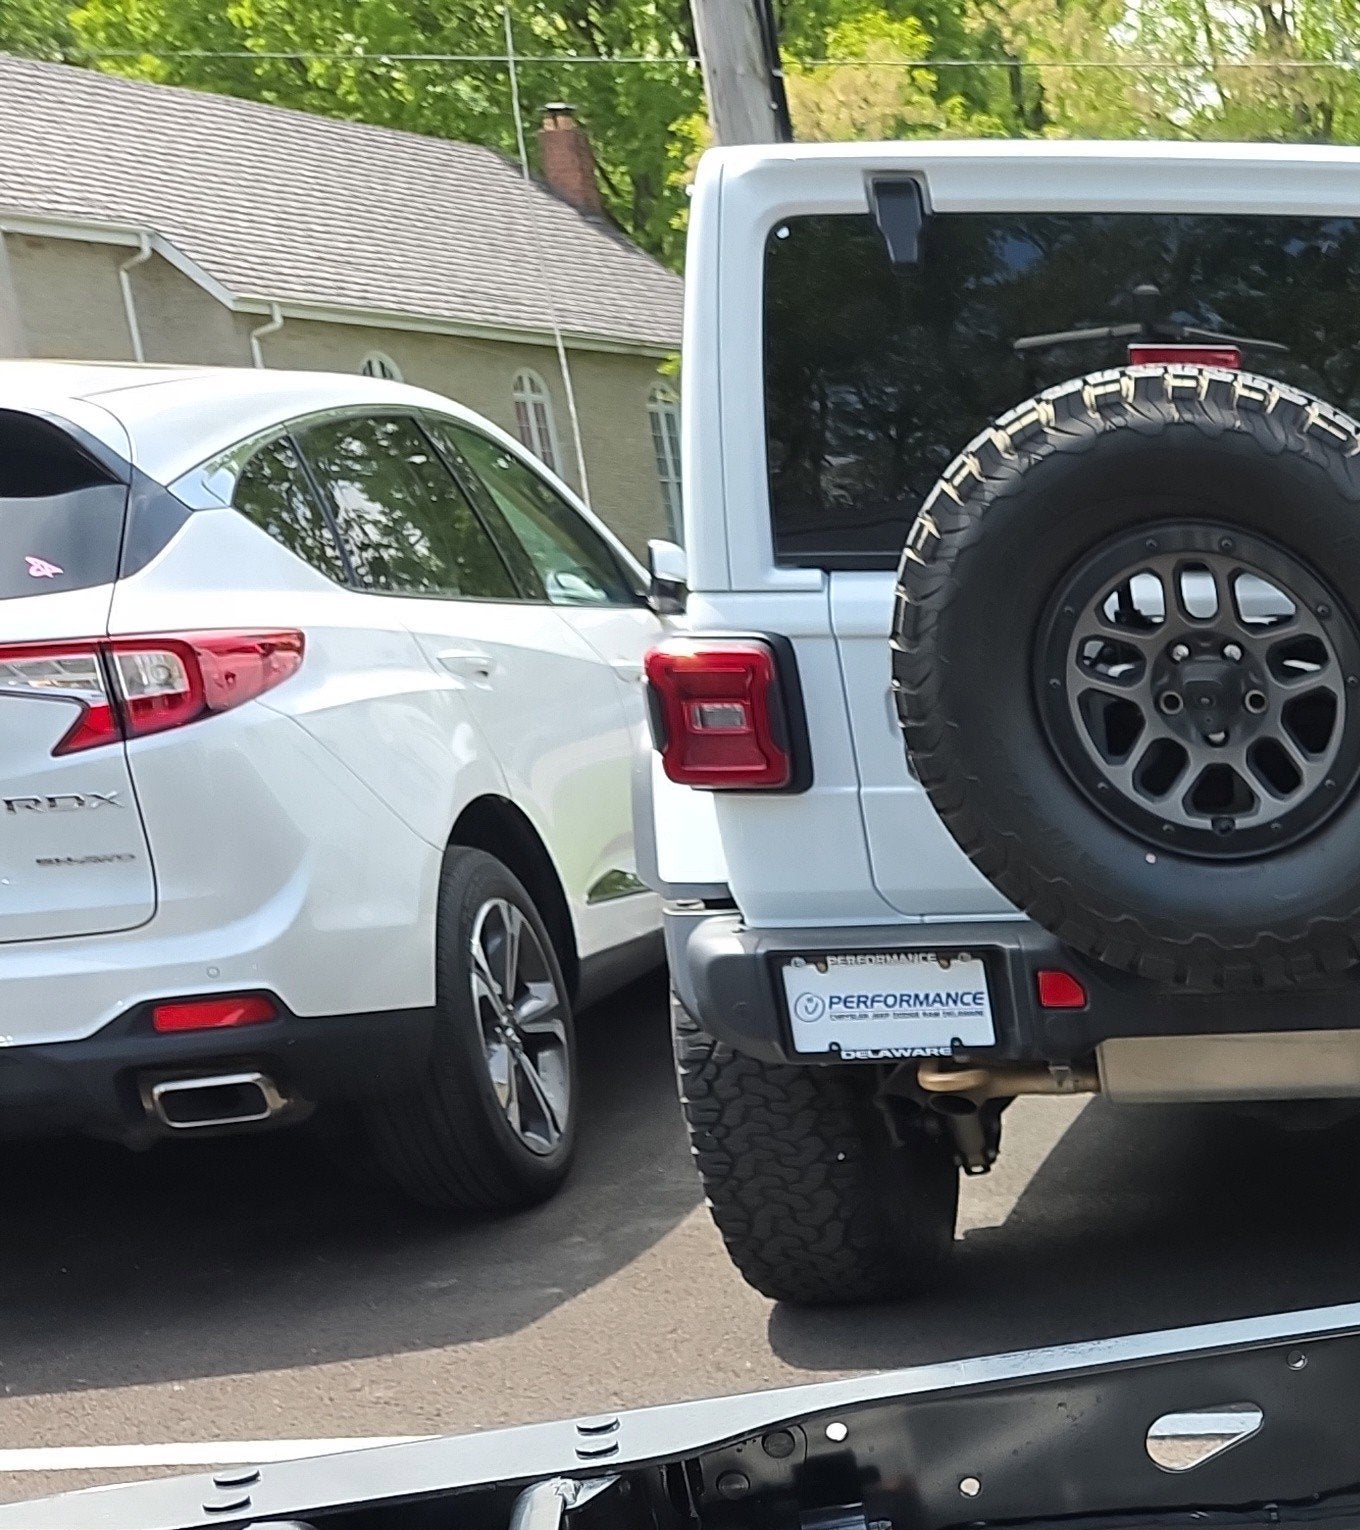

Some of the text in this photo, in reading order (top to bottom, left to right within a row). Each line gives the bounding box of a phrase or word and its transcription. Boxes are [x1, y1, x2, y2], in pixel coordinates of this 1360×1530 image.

[3, 791, 126, 814] RDX
[826, 953, 938, 967] PERFORMANCE
[828, 991, 985, 1011] PERFORMANCE
[840, 1047, 953, 1061] DELAWARE
